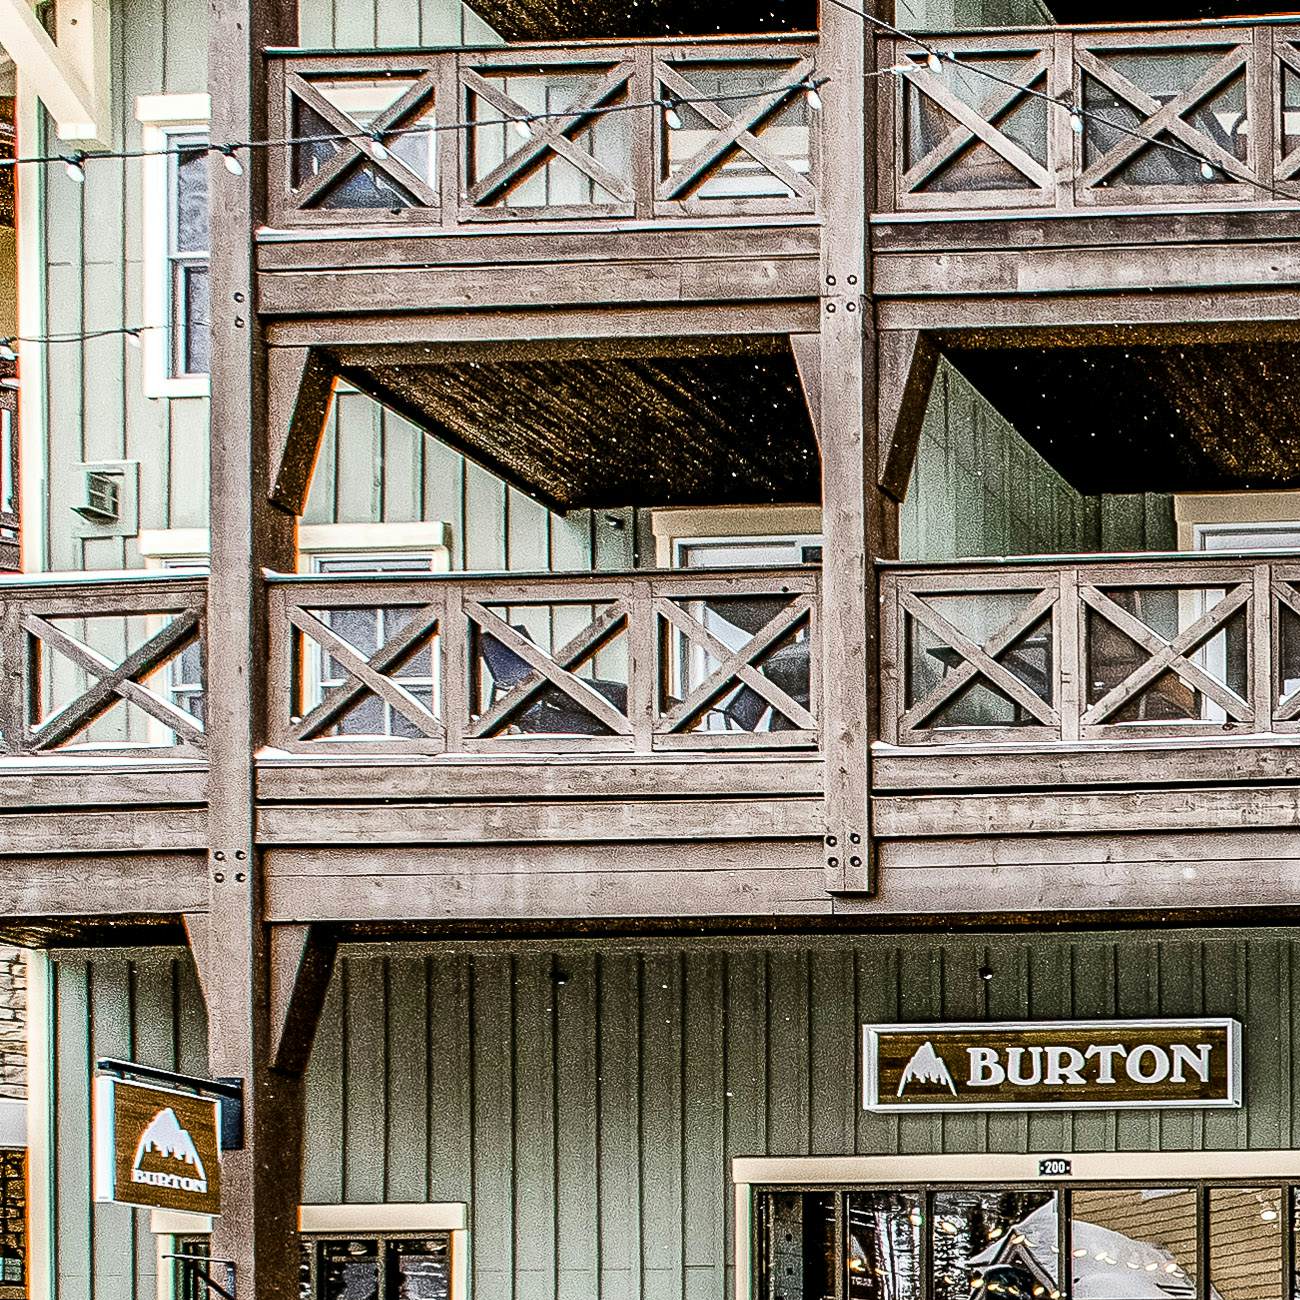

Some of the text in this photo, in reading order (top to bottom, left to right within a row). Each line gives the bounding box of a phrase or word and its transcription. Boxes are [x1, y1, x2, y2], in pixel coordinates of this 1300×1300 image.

[966, 1043, 1213, 1087] BURTON
[130, 1168, 208, 1194] BURTON
[1044, 1161, 1067, 1175] 200
